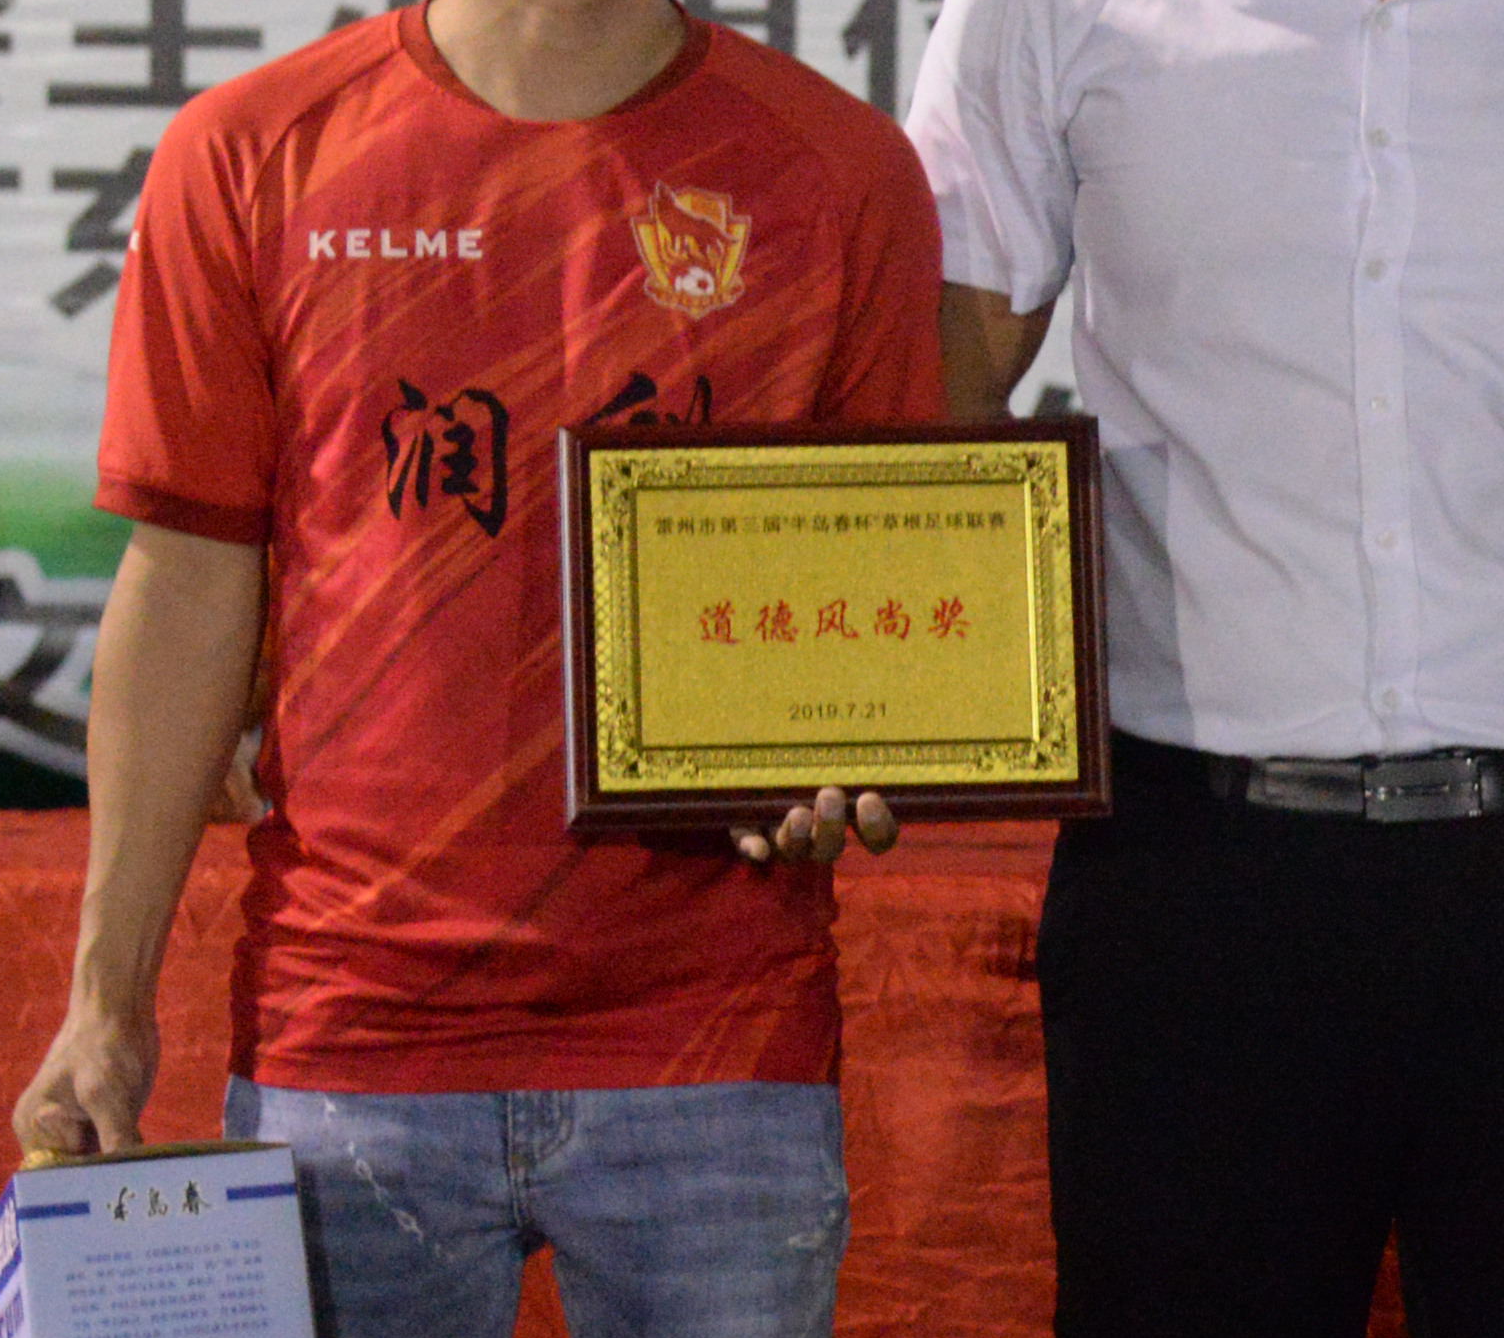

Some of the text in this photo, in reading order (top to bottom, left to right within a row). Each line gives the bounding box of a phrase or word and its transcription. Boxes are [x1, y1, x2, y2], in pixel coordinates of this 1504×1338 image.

[307, 227, 484, 260] KELME
[698, 595, 972, 646] 道德风尚奖
[788, 701, 889, 722] 2019.7.21
